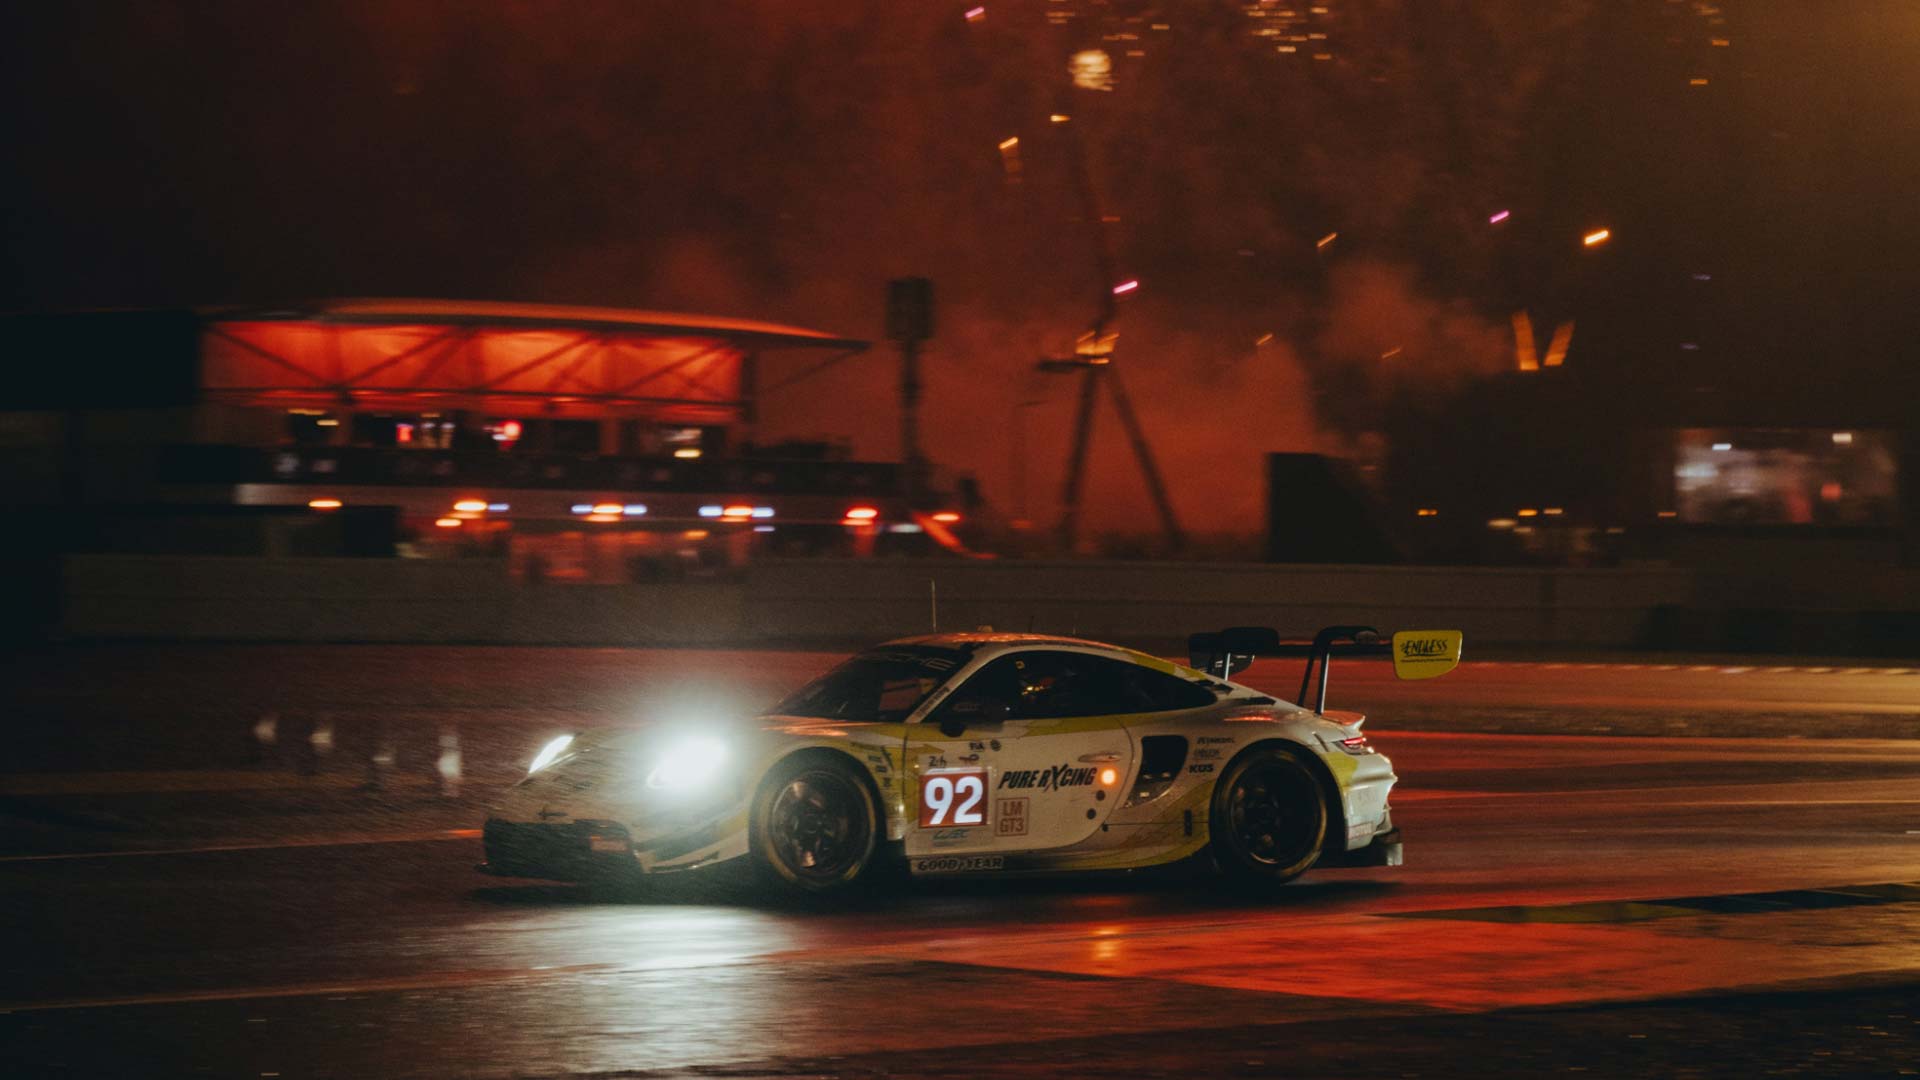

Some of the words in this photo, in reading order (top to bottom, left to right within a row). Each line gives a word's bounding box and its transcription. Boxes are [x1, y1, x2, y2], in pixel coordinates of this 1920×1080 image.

[1400, 639, 1448, 656] ENDLESS
[998, 770, 1039, 789] PURE
[924, 775, 984, 825] 92
[1003, 801, 1023, 816] LM
[1000, 818, 1024, 833] GT3
